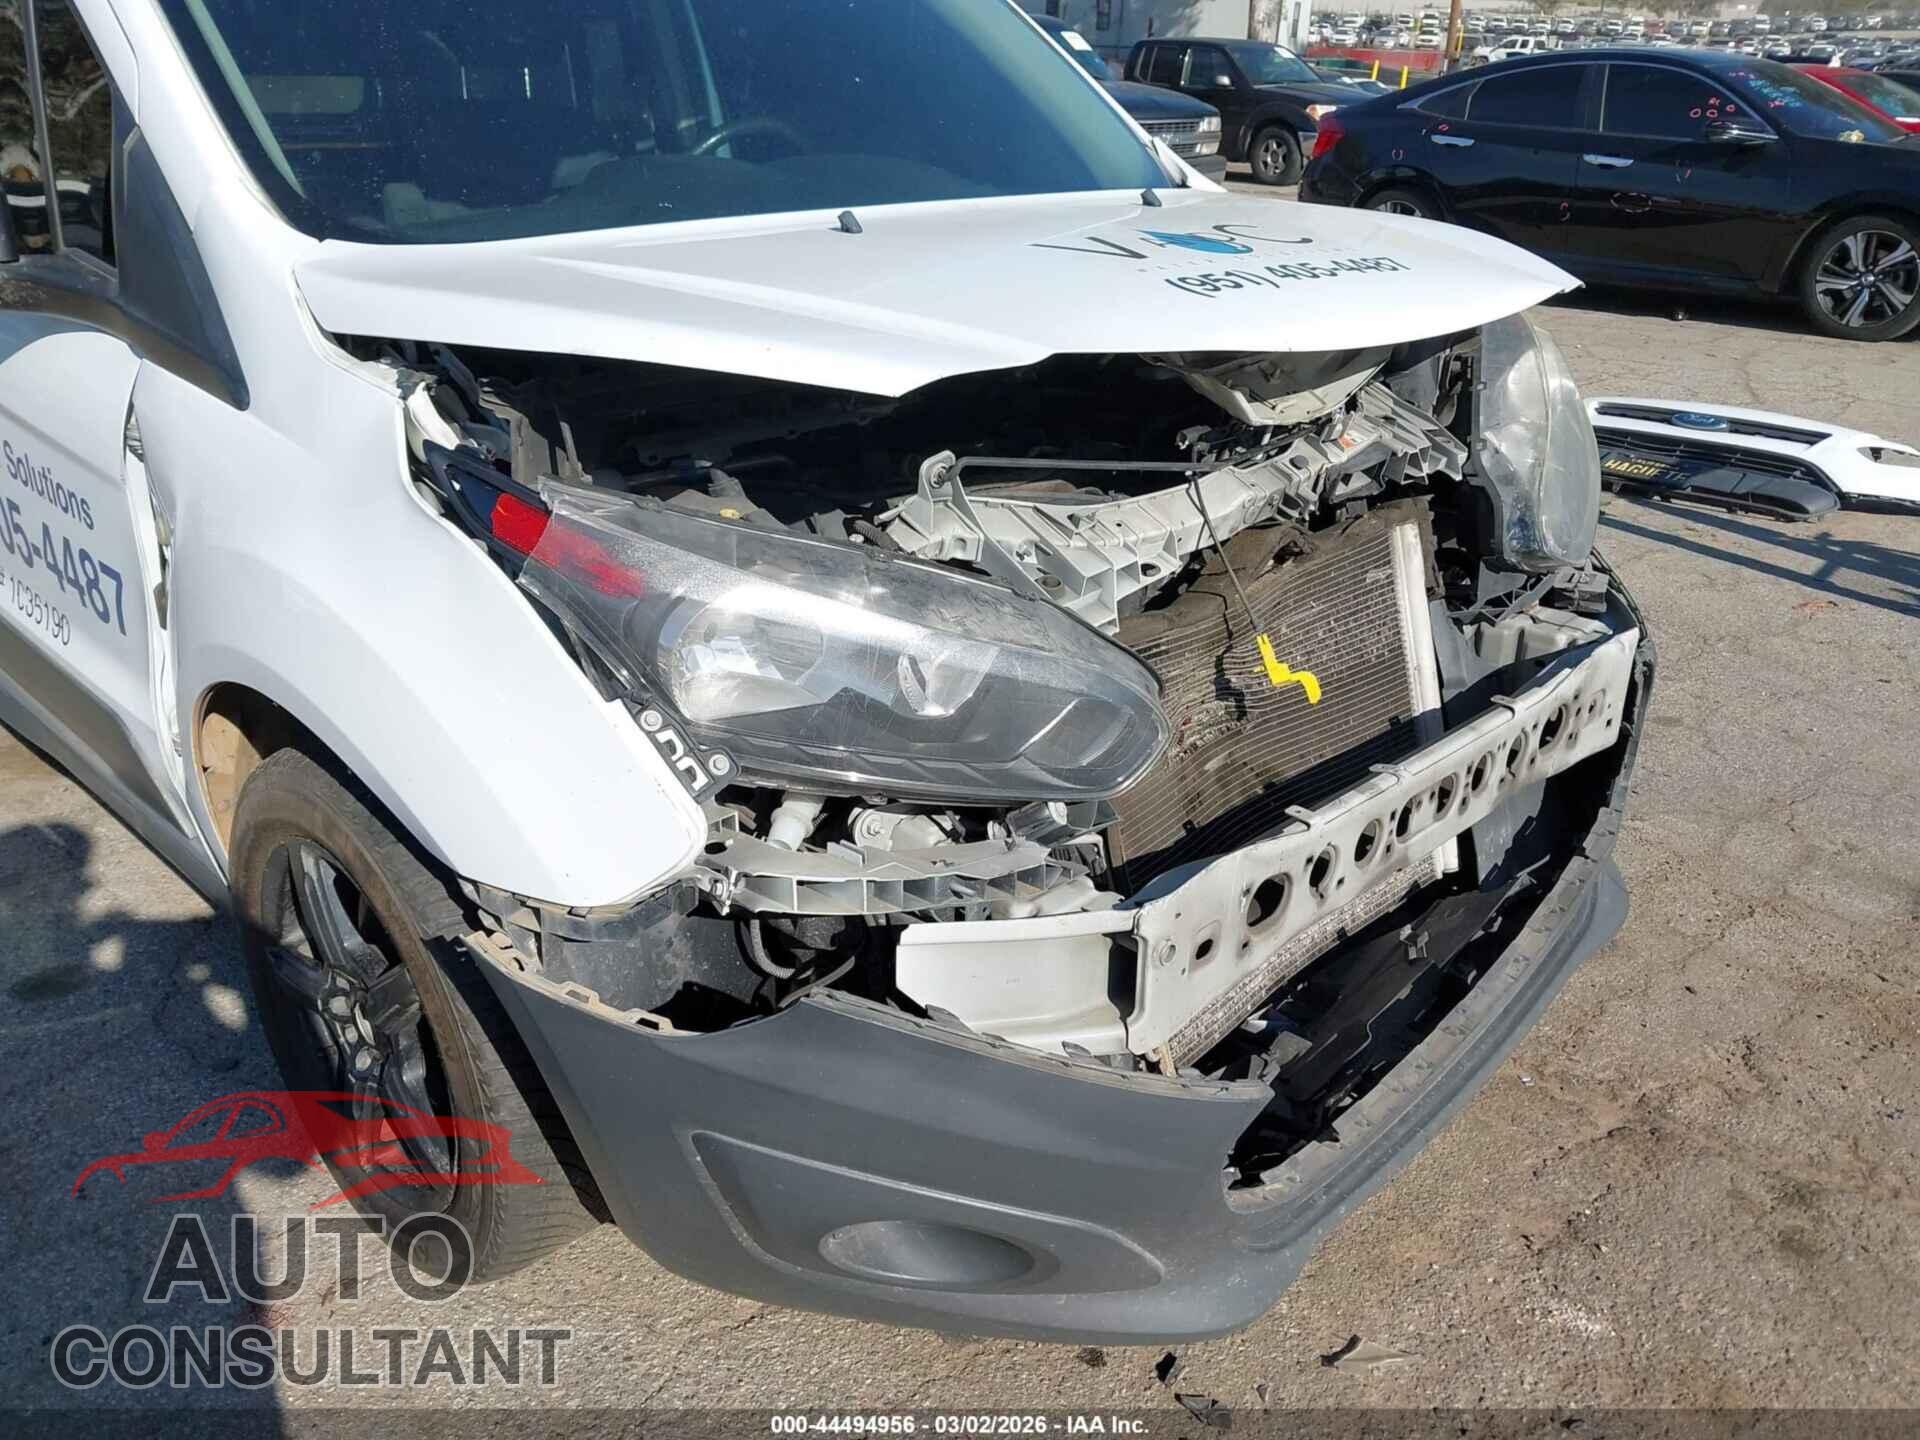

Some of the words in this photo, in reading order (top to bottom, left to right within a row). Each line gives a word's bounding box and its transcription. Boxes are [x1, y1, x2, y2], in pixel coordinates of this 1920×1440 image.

[1164, 269, 1280, 298] (951)
[1264, 257, 1411, 280] 405-4487
[3, 440, 95, 530] Solutions
